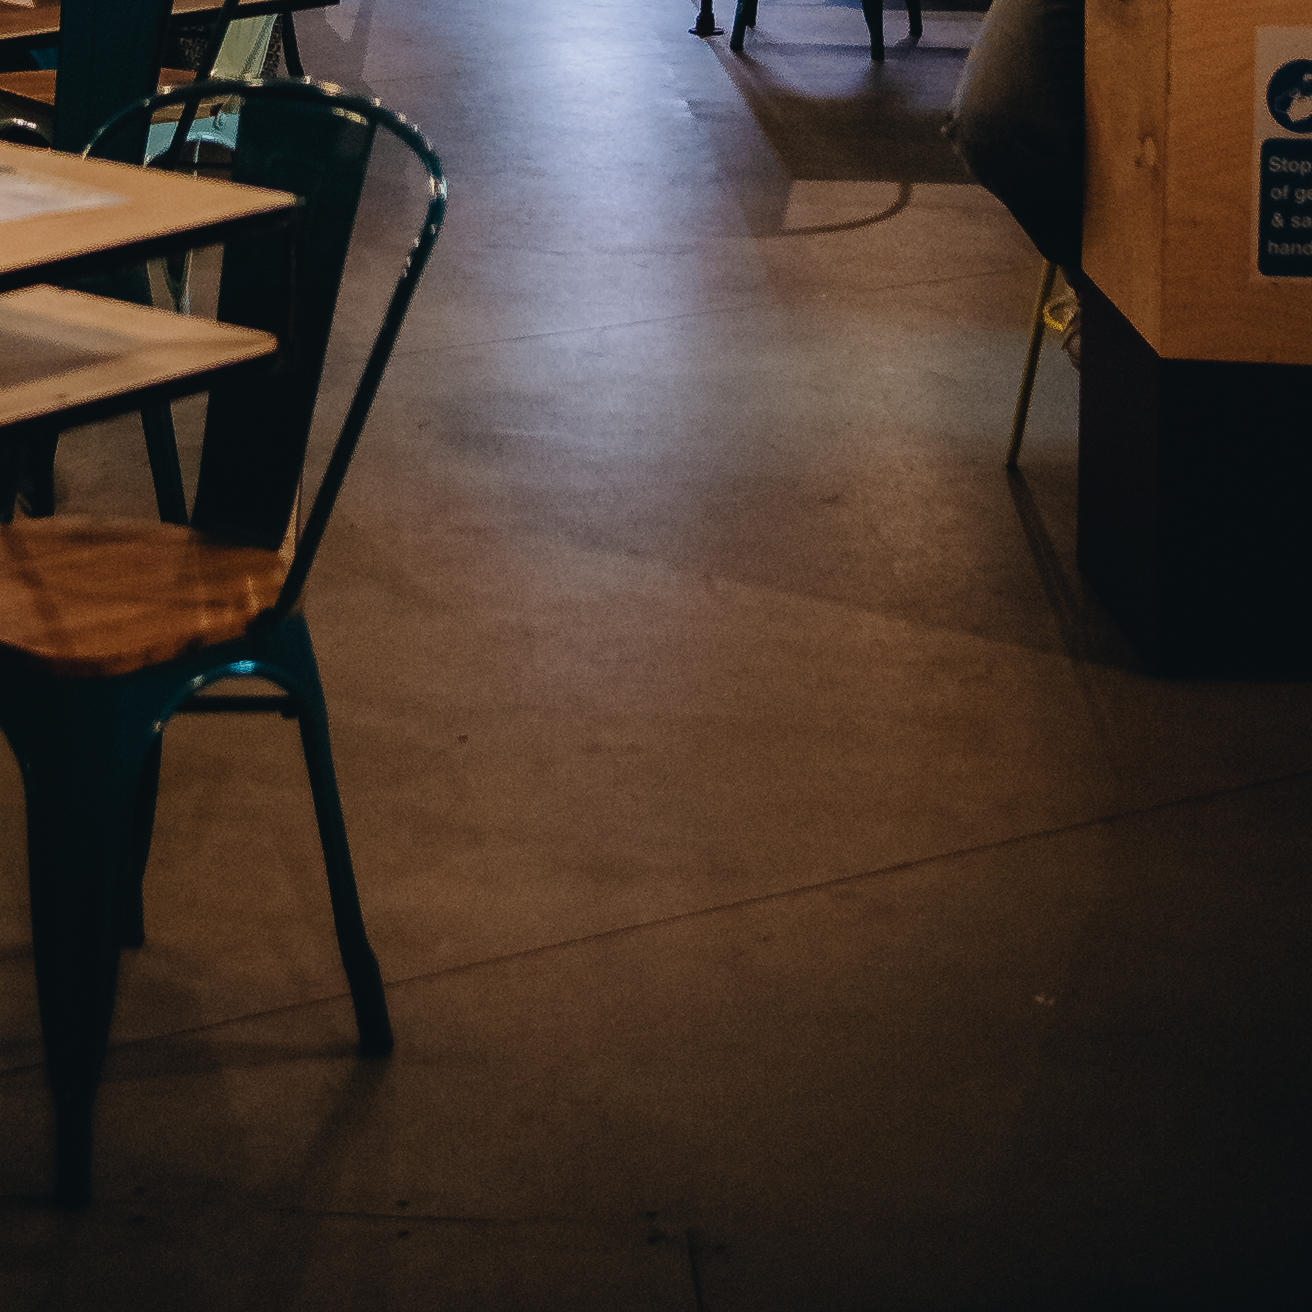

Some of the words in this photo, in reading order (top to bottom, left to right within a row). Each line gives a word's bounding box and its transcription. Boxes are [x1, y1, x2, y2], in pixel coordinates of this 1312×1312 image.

[1269, 155, 1312, 177] Stop
[1270, 185, 1290, 200] of
[1271, 212, 1285, 228] &
